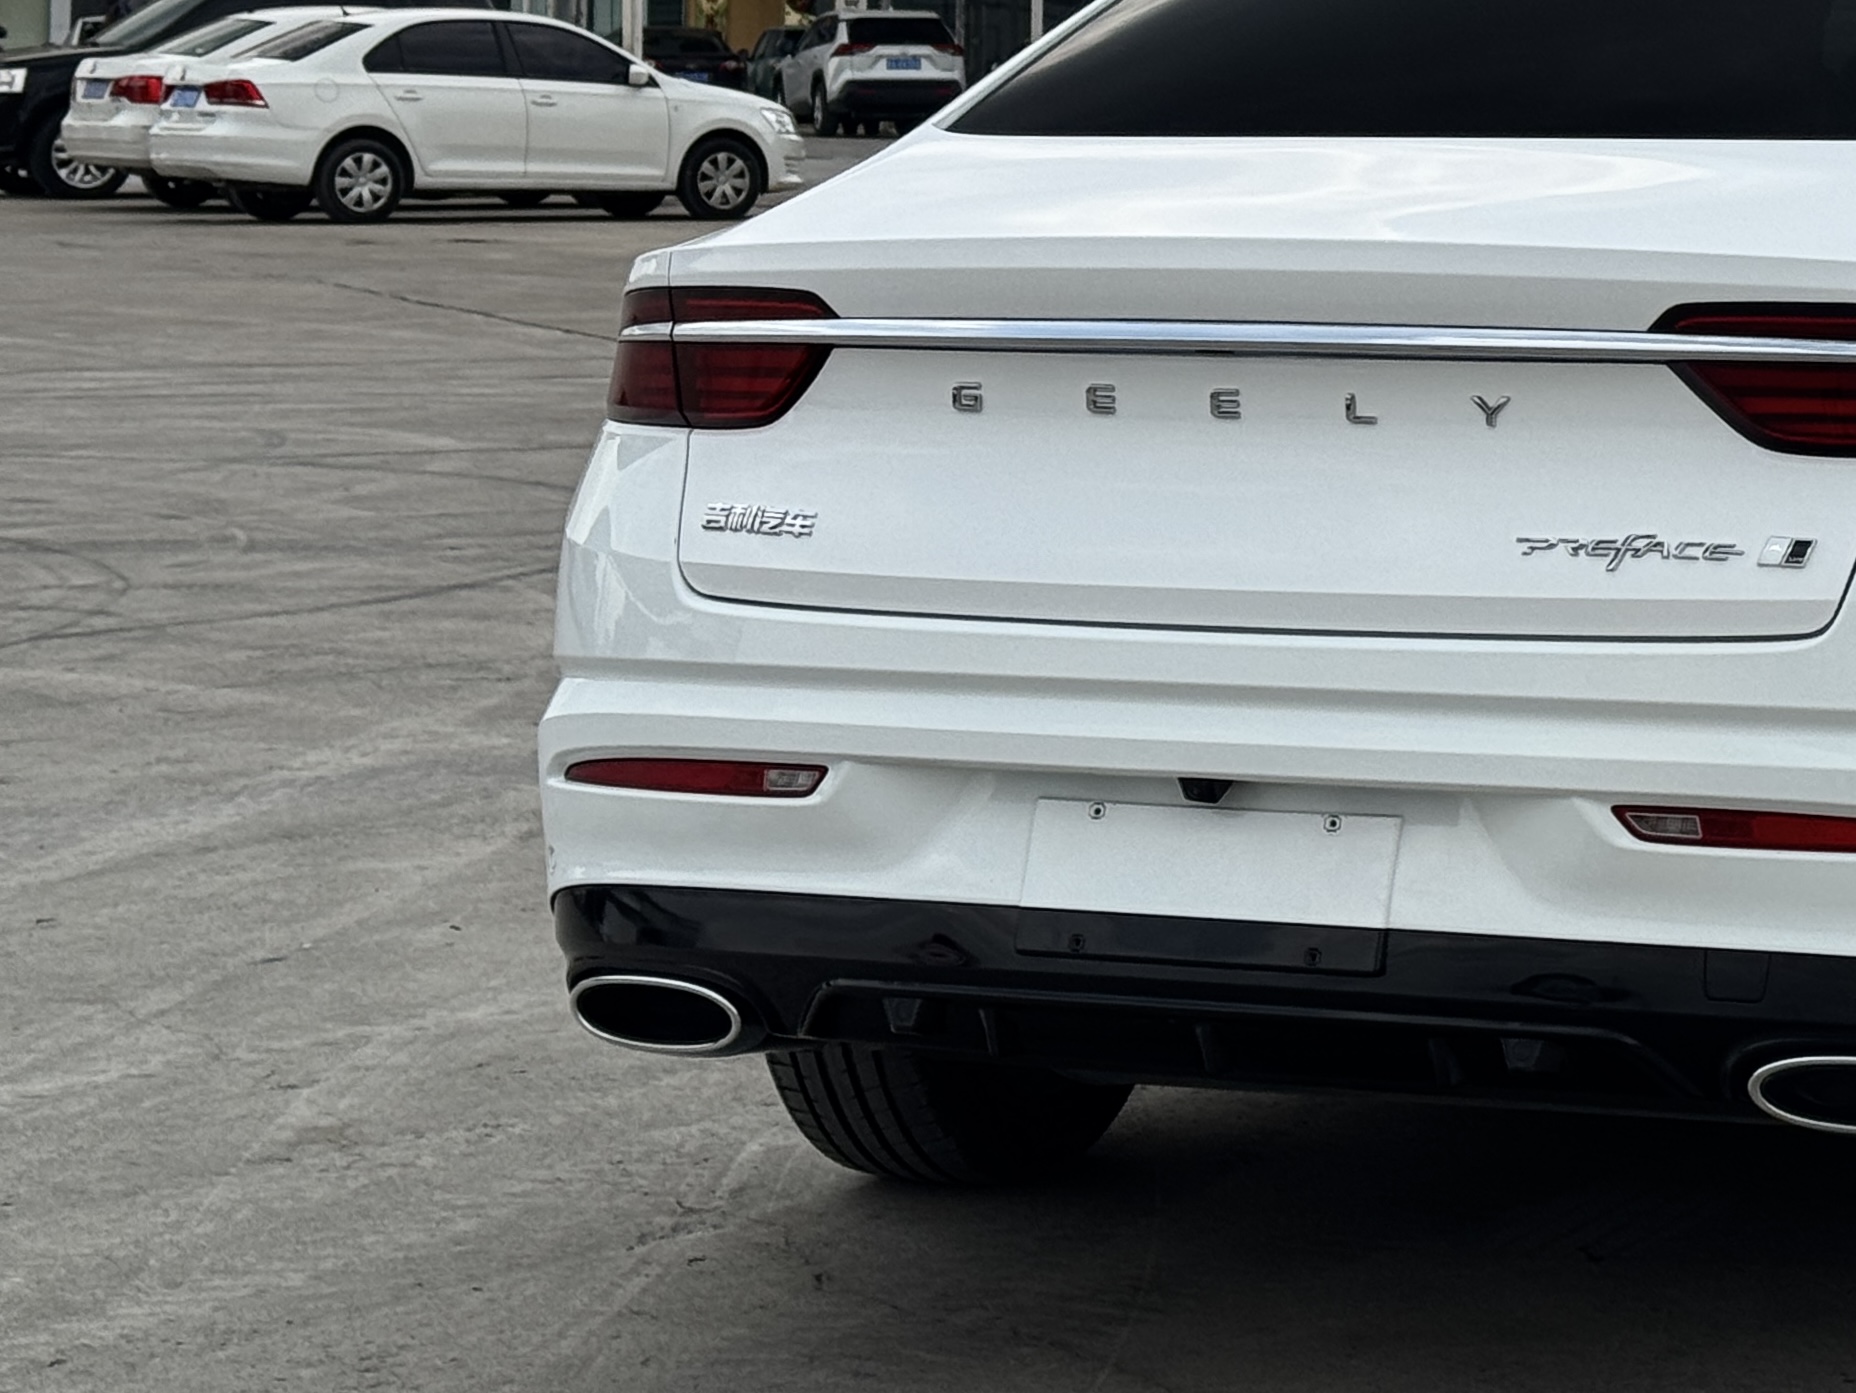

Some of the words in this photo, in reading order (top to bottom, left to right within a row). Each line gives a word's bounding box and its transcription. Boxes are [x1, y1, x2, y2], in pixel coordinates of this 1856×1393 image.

[952, 381, 1511, 428] GEELY
[701, 502, 819, 539] 吉利汽车
